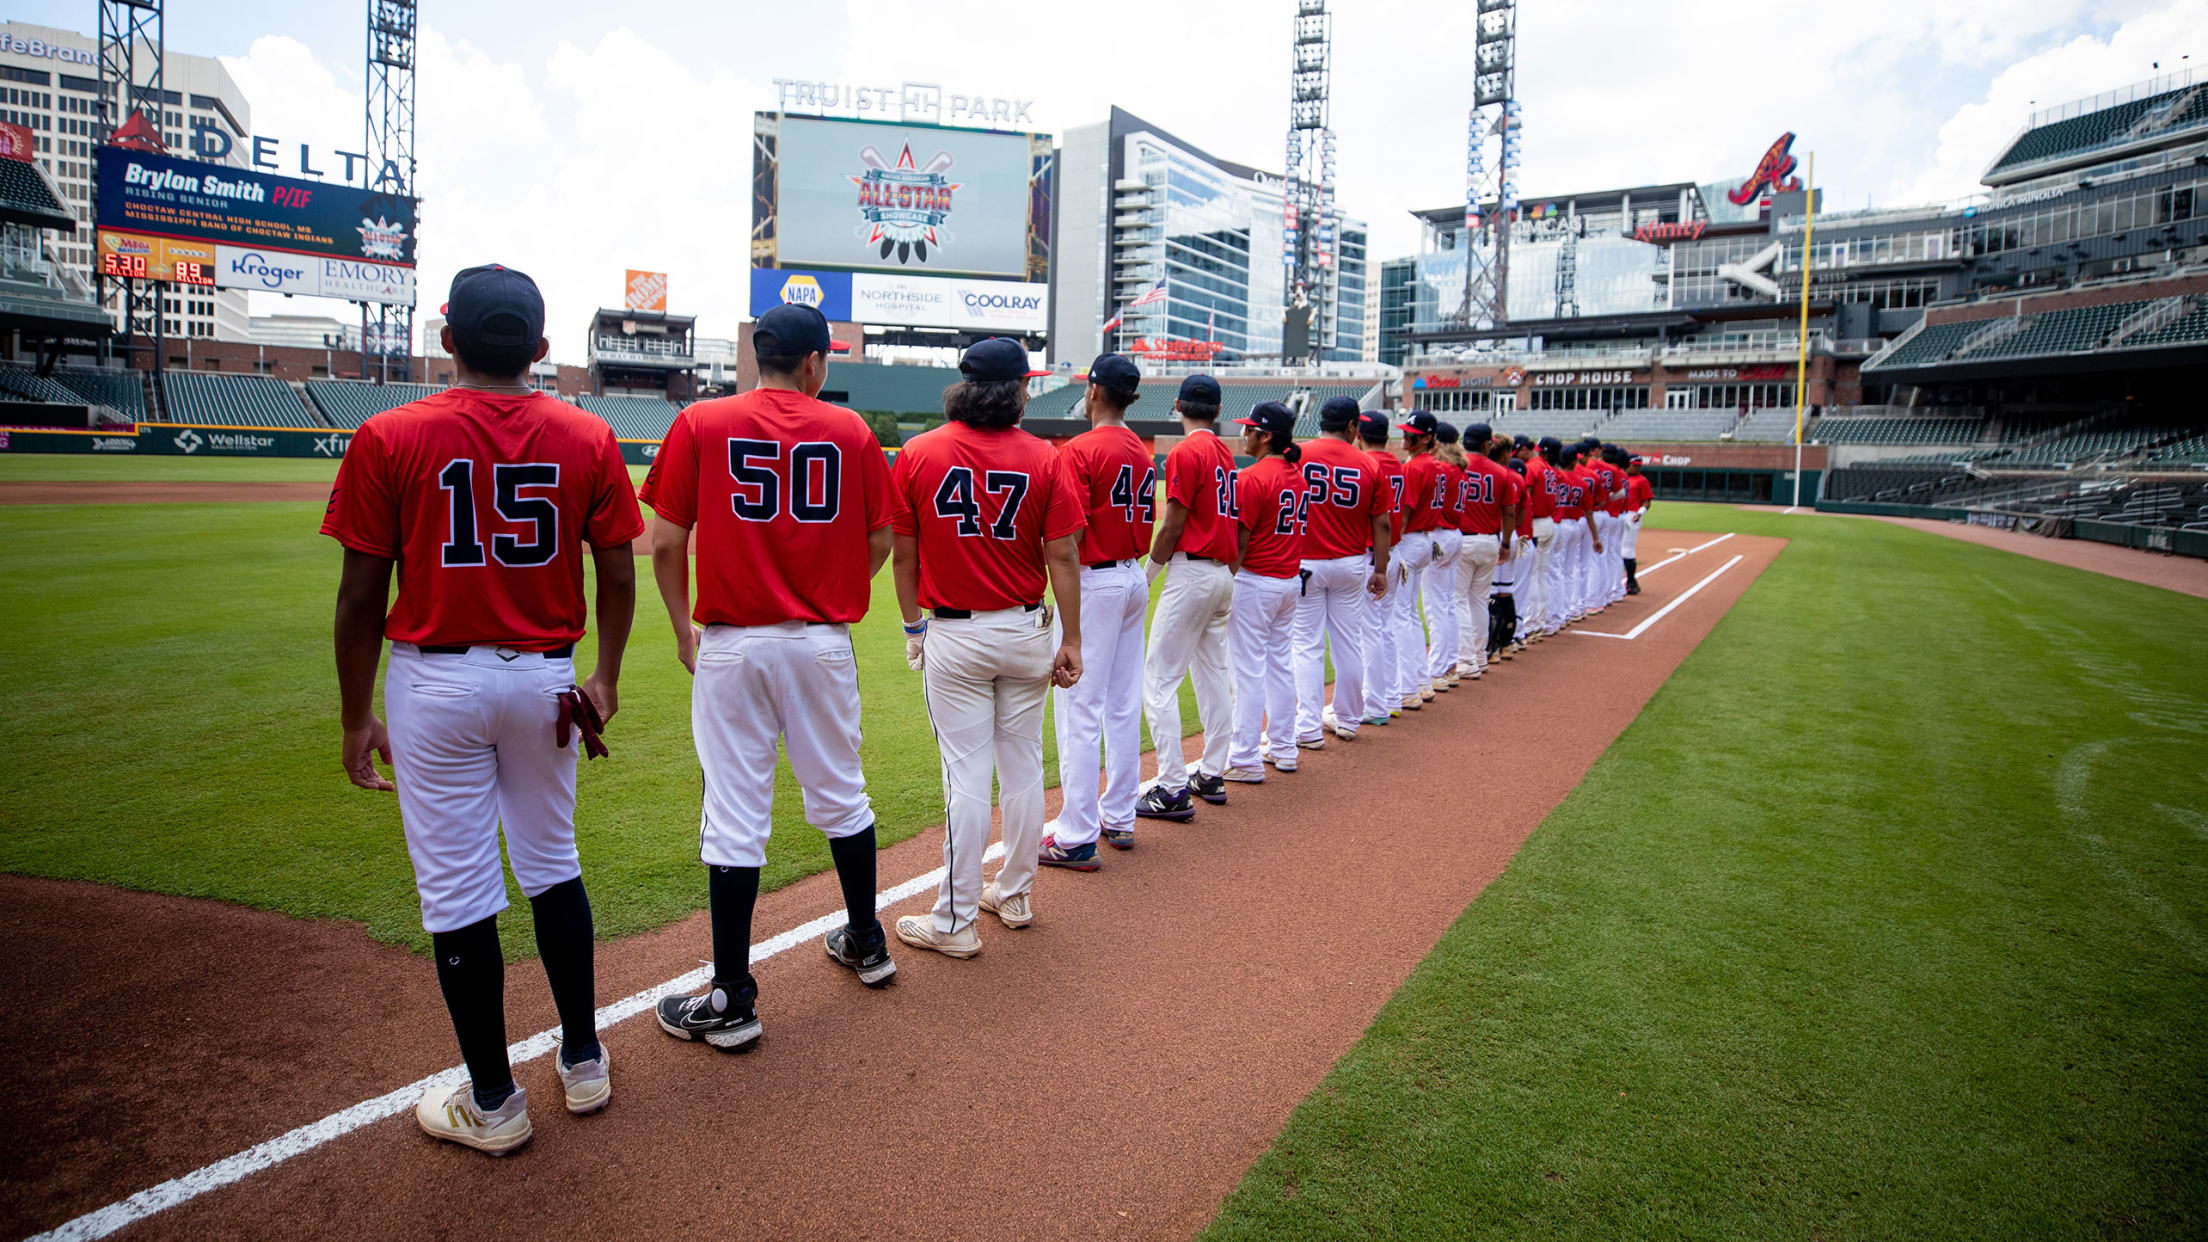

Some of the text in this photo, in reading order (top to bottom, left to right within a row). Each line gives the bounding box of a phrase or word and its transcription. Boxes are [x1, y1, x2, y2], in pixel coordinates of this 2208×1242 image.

[772, 78, 1035, 124] TRUIST PARK
[195, 123, 408, 193] DELTA
[124, 162, 313, 208] Brylon Smith P/IF
[125, 187, 229, 209] RISING SENIOR
[125, 202, 176, 215] CHOCTAW
[179, 209, 224, 222] CENTRAL
[227, 216, 252, 226] HIGH
[125, 210, 334, 245] MISSISSIPPI BAND OF CHOCTAW INDIANS
[1633, 219, 1707, 243] xfinity
[105, 252, 146, 272] 530
[105, 266, 146, 278] MILLION
[176, 260, 201, 278] 89
[232, 252, 304, 288] Kroger
[325, 259, 409, 285] EMORY
[176, 274, 214, 286] MILLION
[787, 286, 817, 303] NAPA
[860, 290, 944, 304] NORTHSIDE
[875, 302, 929, 312] HOSPITAL
[964, 292, 1042, 310] COOLRAY
[1535, 371, 1633, 386] CHOP HOUSE
[1688, 369, 1720, 379] MADE
[1722, 368, 1738, 379] TO
[208, 433, 275, 447] Wellstar
[728, 437, 842, 524] 50
[1302, 462, 1361, 509] 65
[1466, 470, 1495, 504] 51
[933, 465, 1031, 541] 47
[1110, 464, 1156, 524] 44
[1385, 475, 1404, 513] 7
[438, 458, 560, 568] 15
[1275, 489, 1311, 536] 24
